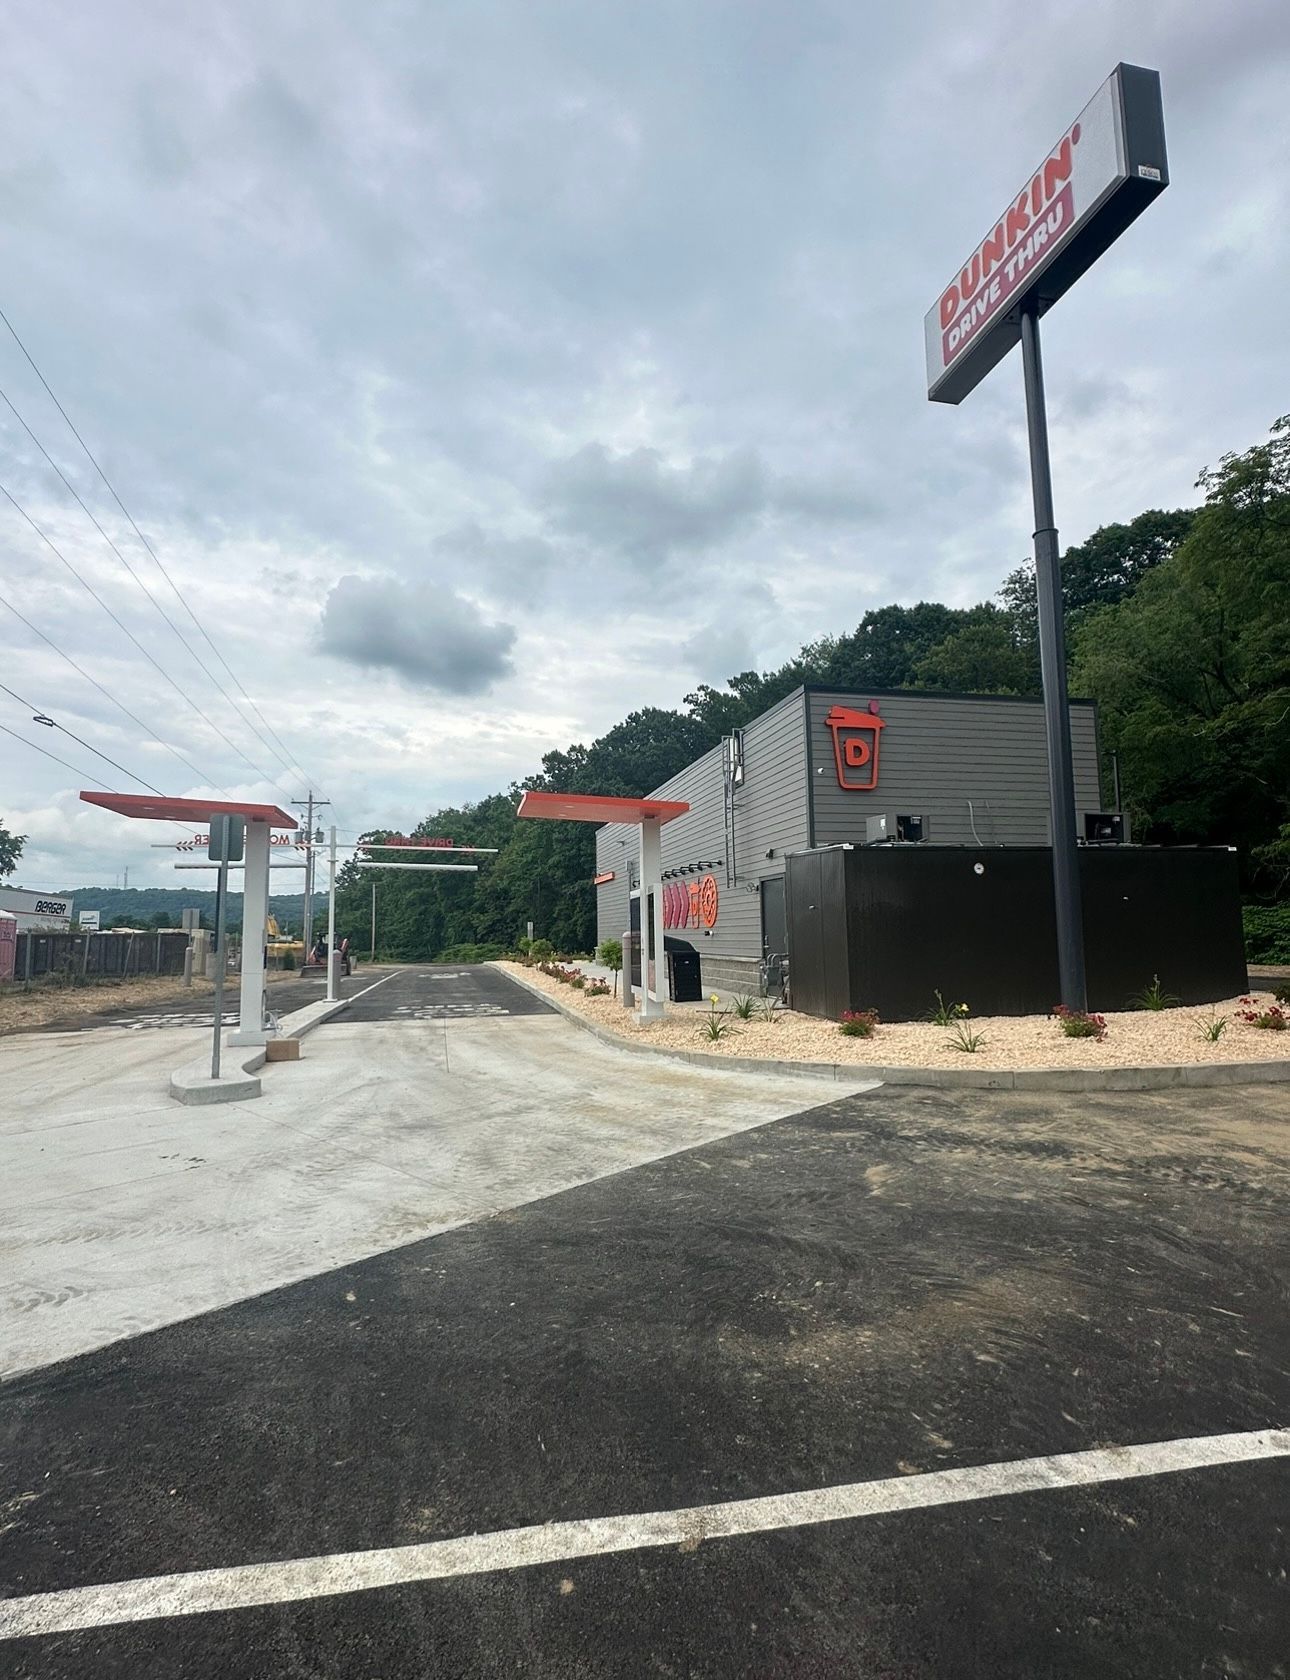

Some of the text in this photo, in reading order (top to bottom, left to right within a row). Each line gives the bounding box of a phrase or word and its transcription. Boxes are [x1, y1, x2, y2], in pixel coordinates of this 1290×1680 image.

[940, 123, 1081, 329] DUNKIN'
[949, 201, 1064, 351] DRIVE THRU
[845, 738, 870, 766] D
[35, 900, 66, 915] BERGER
